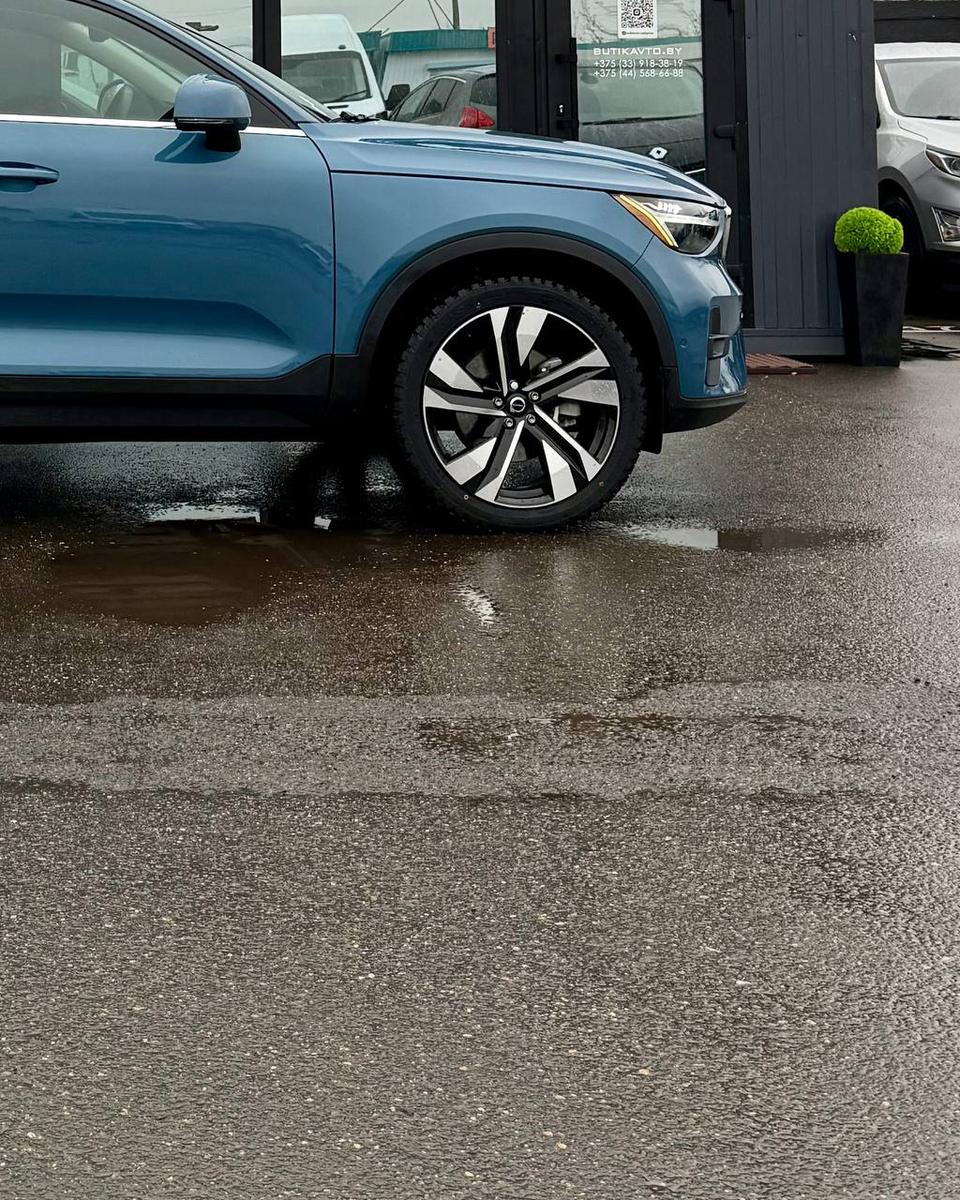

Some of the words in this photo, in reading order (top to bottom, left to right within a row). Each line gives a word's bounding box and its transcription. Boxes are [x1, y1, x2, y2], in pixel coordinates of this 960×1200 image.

[594, 48, 682, 56] BUTIKAVTO.BY
[594, 60, 616, 68] +375
[619, 59, 636, 69] (33)
[639, 59, 683, 68] 918-38-19
[594, 69, 616, 77] +375
[620, 69, 636, 79] (44)
